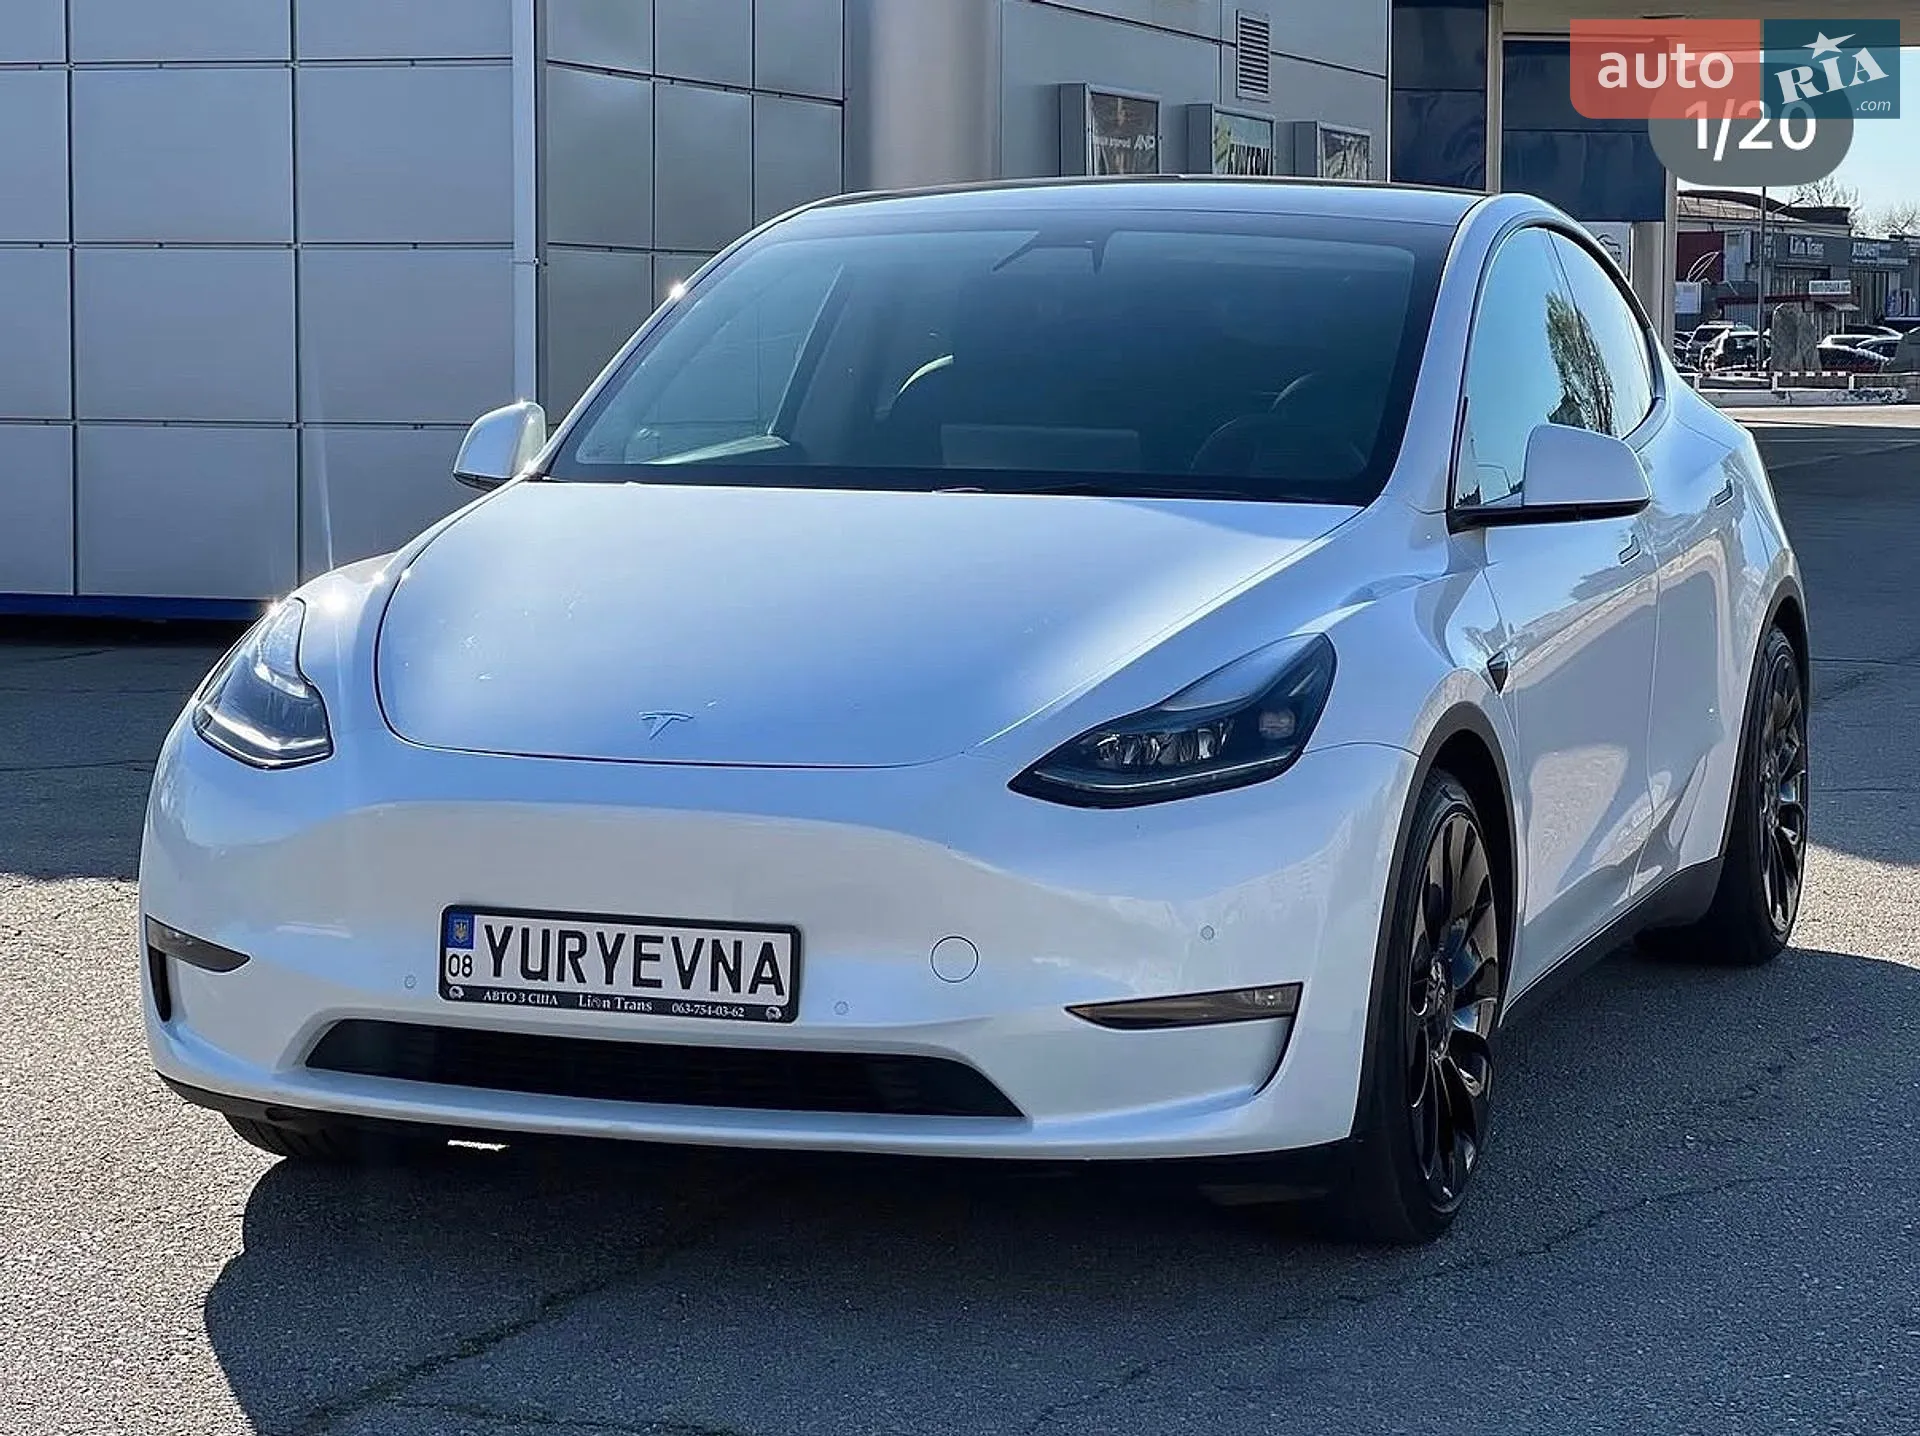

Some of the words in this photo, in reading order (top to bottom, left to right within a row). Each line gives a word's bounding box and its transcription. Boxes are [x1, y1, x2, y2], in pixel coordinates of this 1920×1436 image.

[448, 953, 472, 978] 08
[484, 924, 785, 997] YURYEVNA
[613, 996, 653, 1013] Trans
